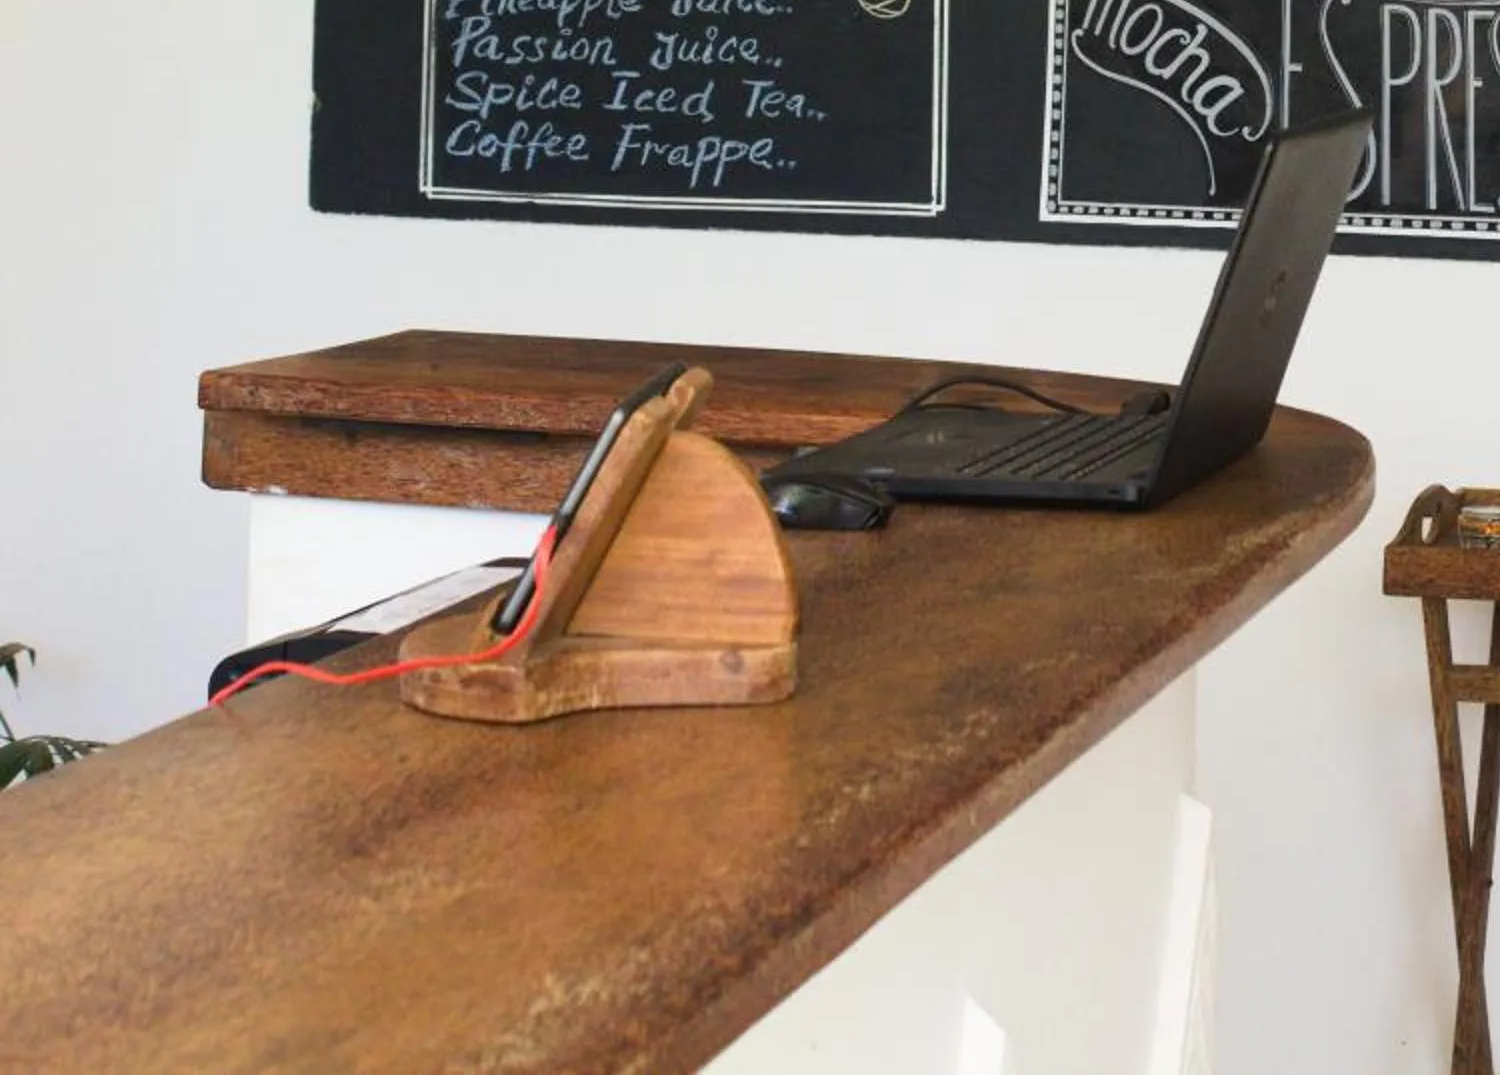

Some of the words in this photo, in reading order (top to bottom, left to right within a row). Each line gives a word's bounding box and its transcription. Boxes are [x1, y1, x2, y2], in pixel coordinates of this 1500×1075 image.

[451, 16, 617, 68] Passion
[445, 70, 583, 119] Spice
[604, 70, 715, 123] Iced
[445, 119, 590, 173] Coffee
